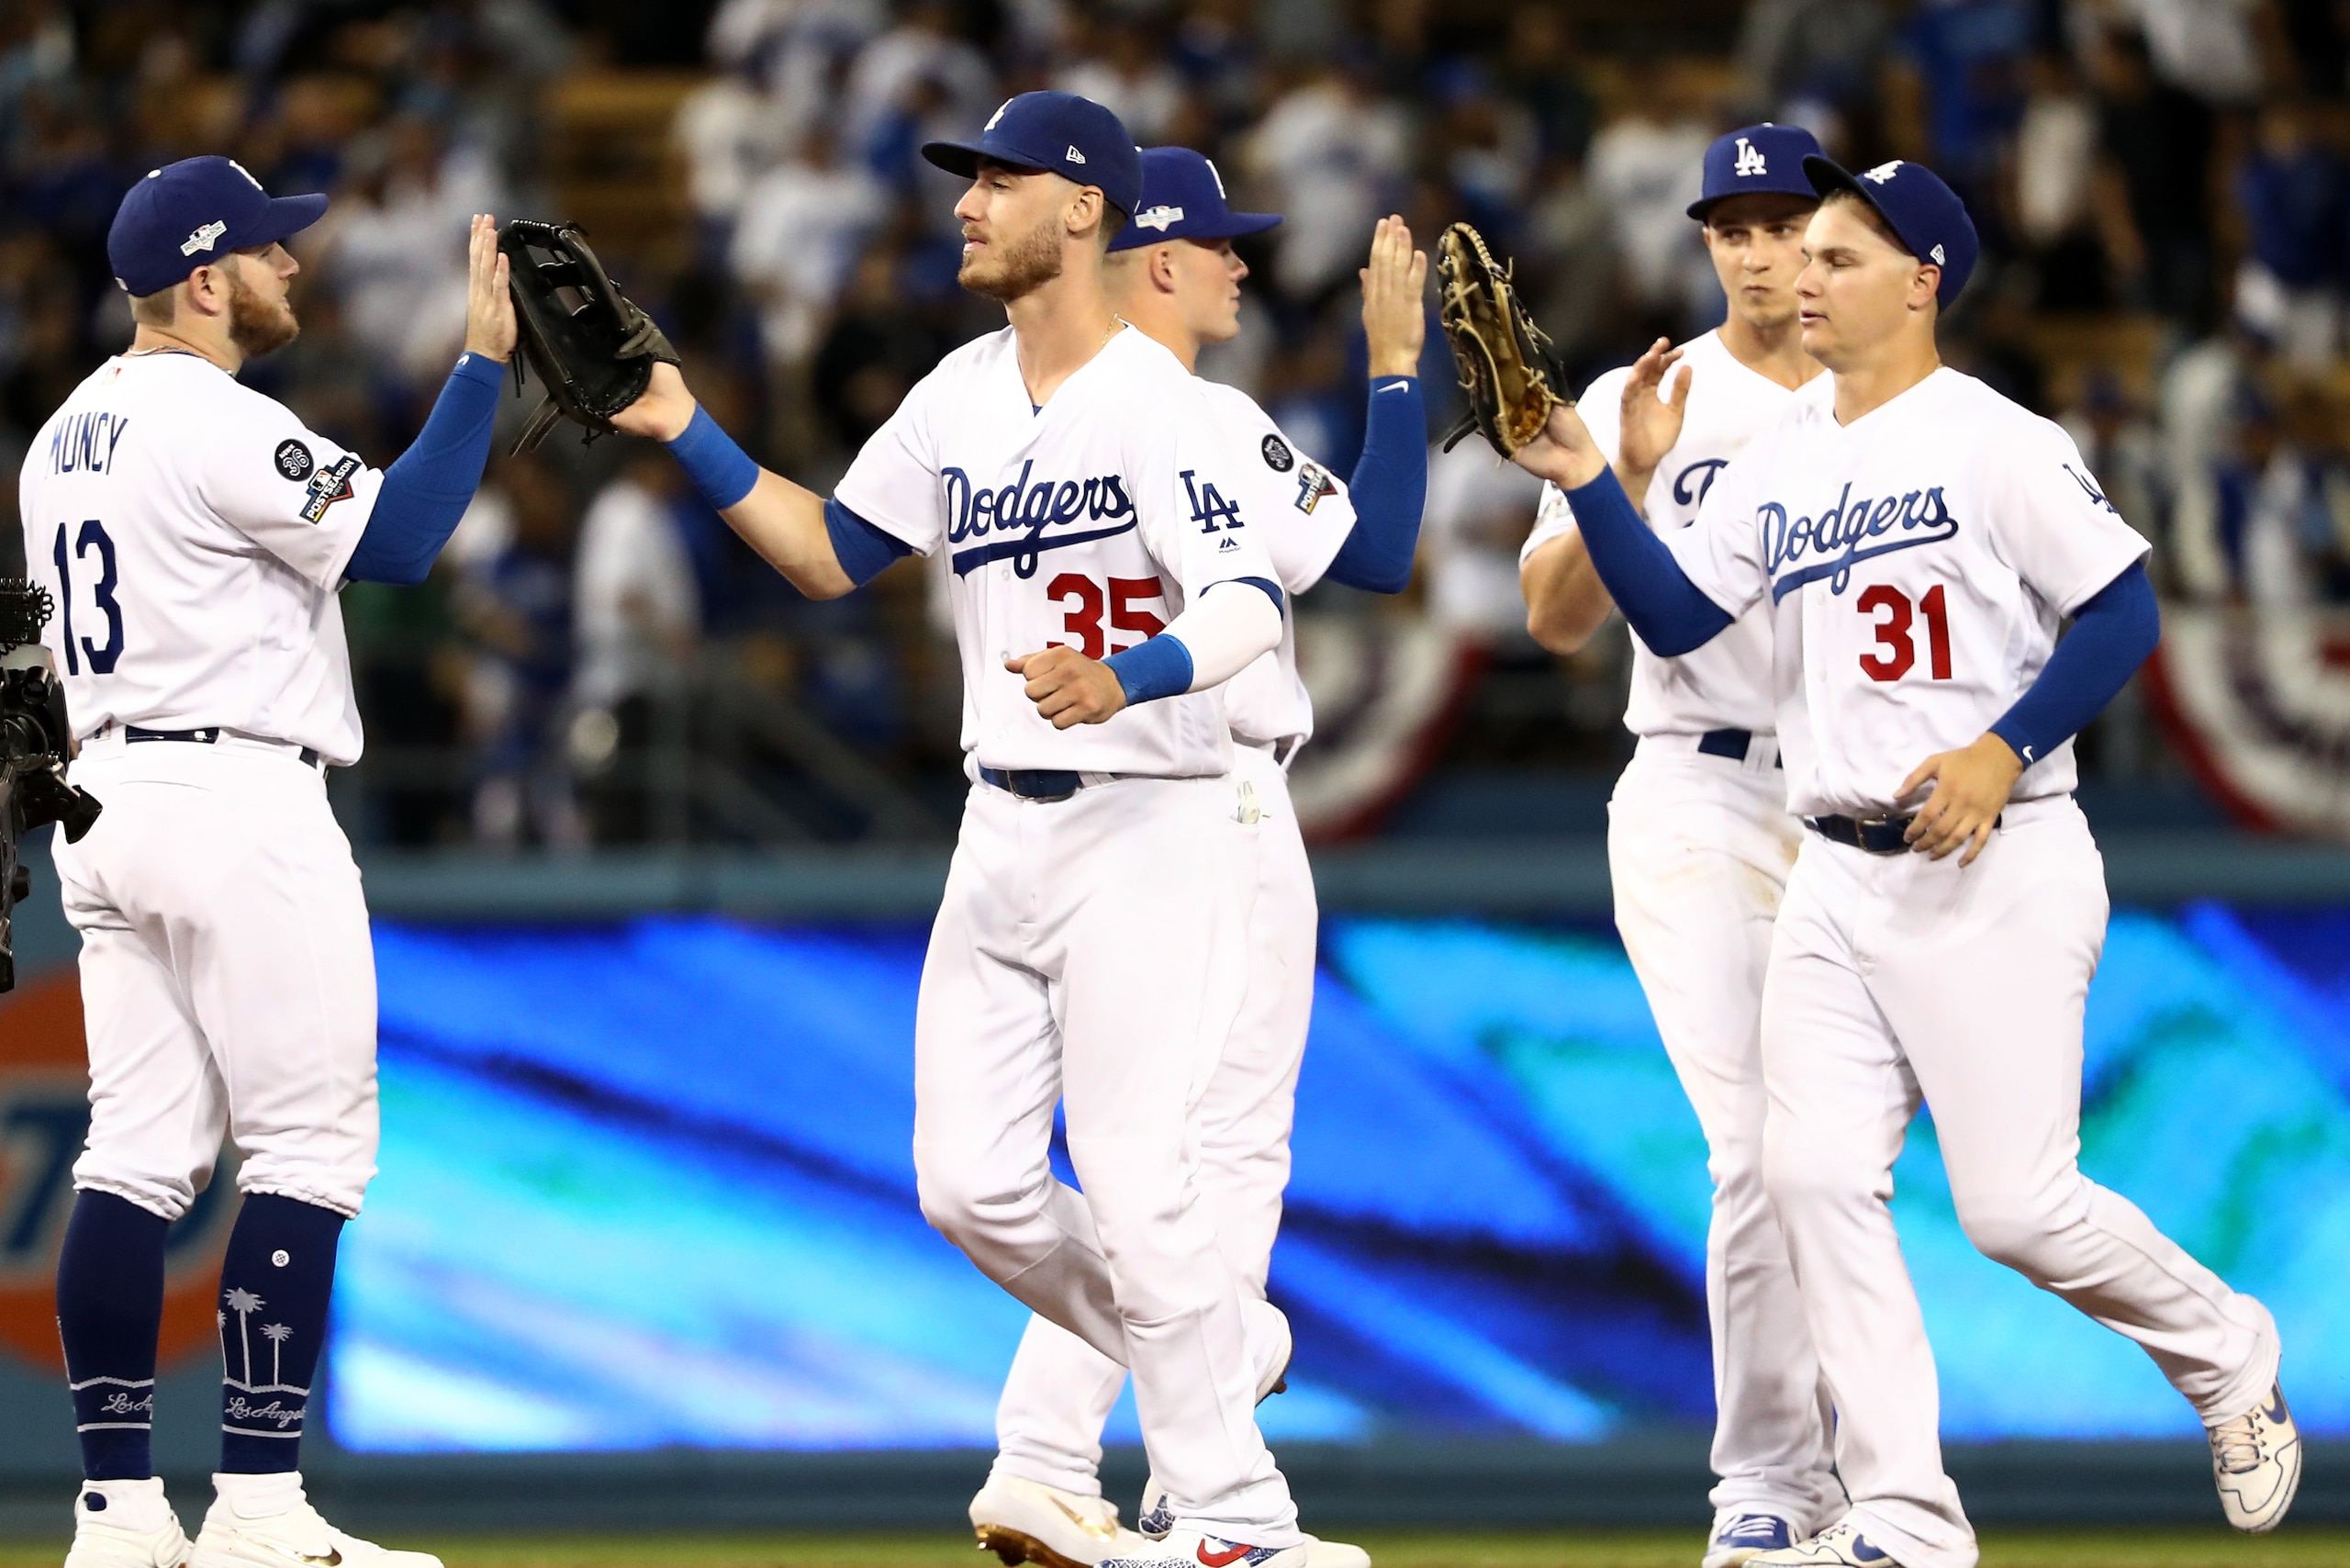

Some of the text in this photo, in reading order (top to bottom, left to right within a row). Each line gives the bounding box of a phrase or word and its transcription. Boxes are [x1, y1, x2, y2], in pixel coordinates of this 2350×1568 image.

[1734, 138, 1768, 177] LA
[45, 411, 129, 480] MUNCY
[283, 448, 310, 476] 36
[306, 458, 355, 520] POSTSEASON
[941, 459, 1138, 581] Dodgers
[1179, 469, 1246, 534] LA
[1757, 481, 1959, 604] Dodgers
[53, 520, 125, 677] 13
[1046, 573, 1168, 661] 35
[1857, 584, 1953, 682] 31
[101, 1392, 135, 1414] Los
[224, 1396, 252, 1419] Los
